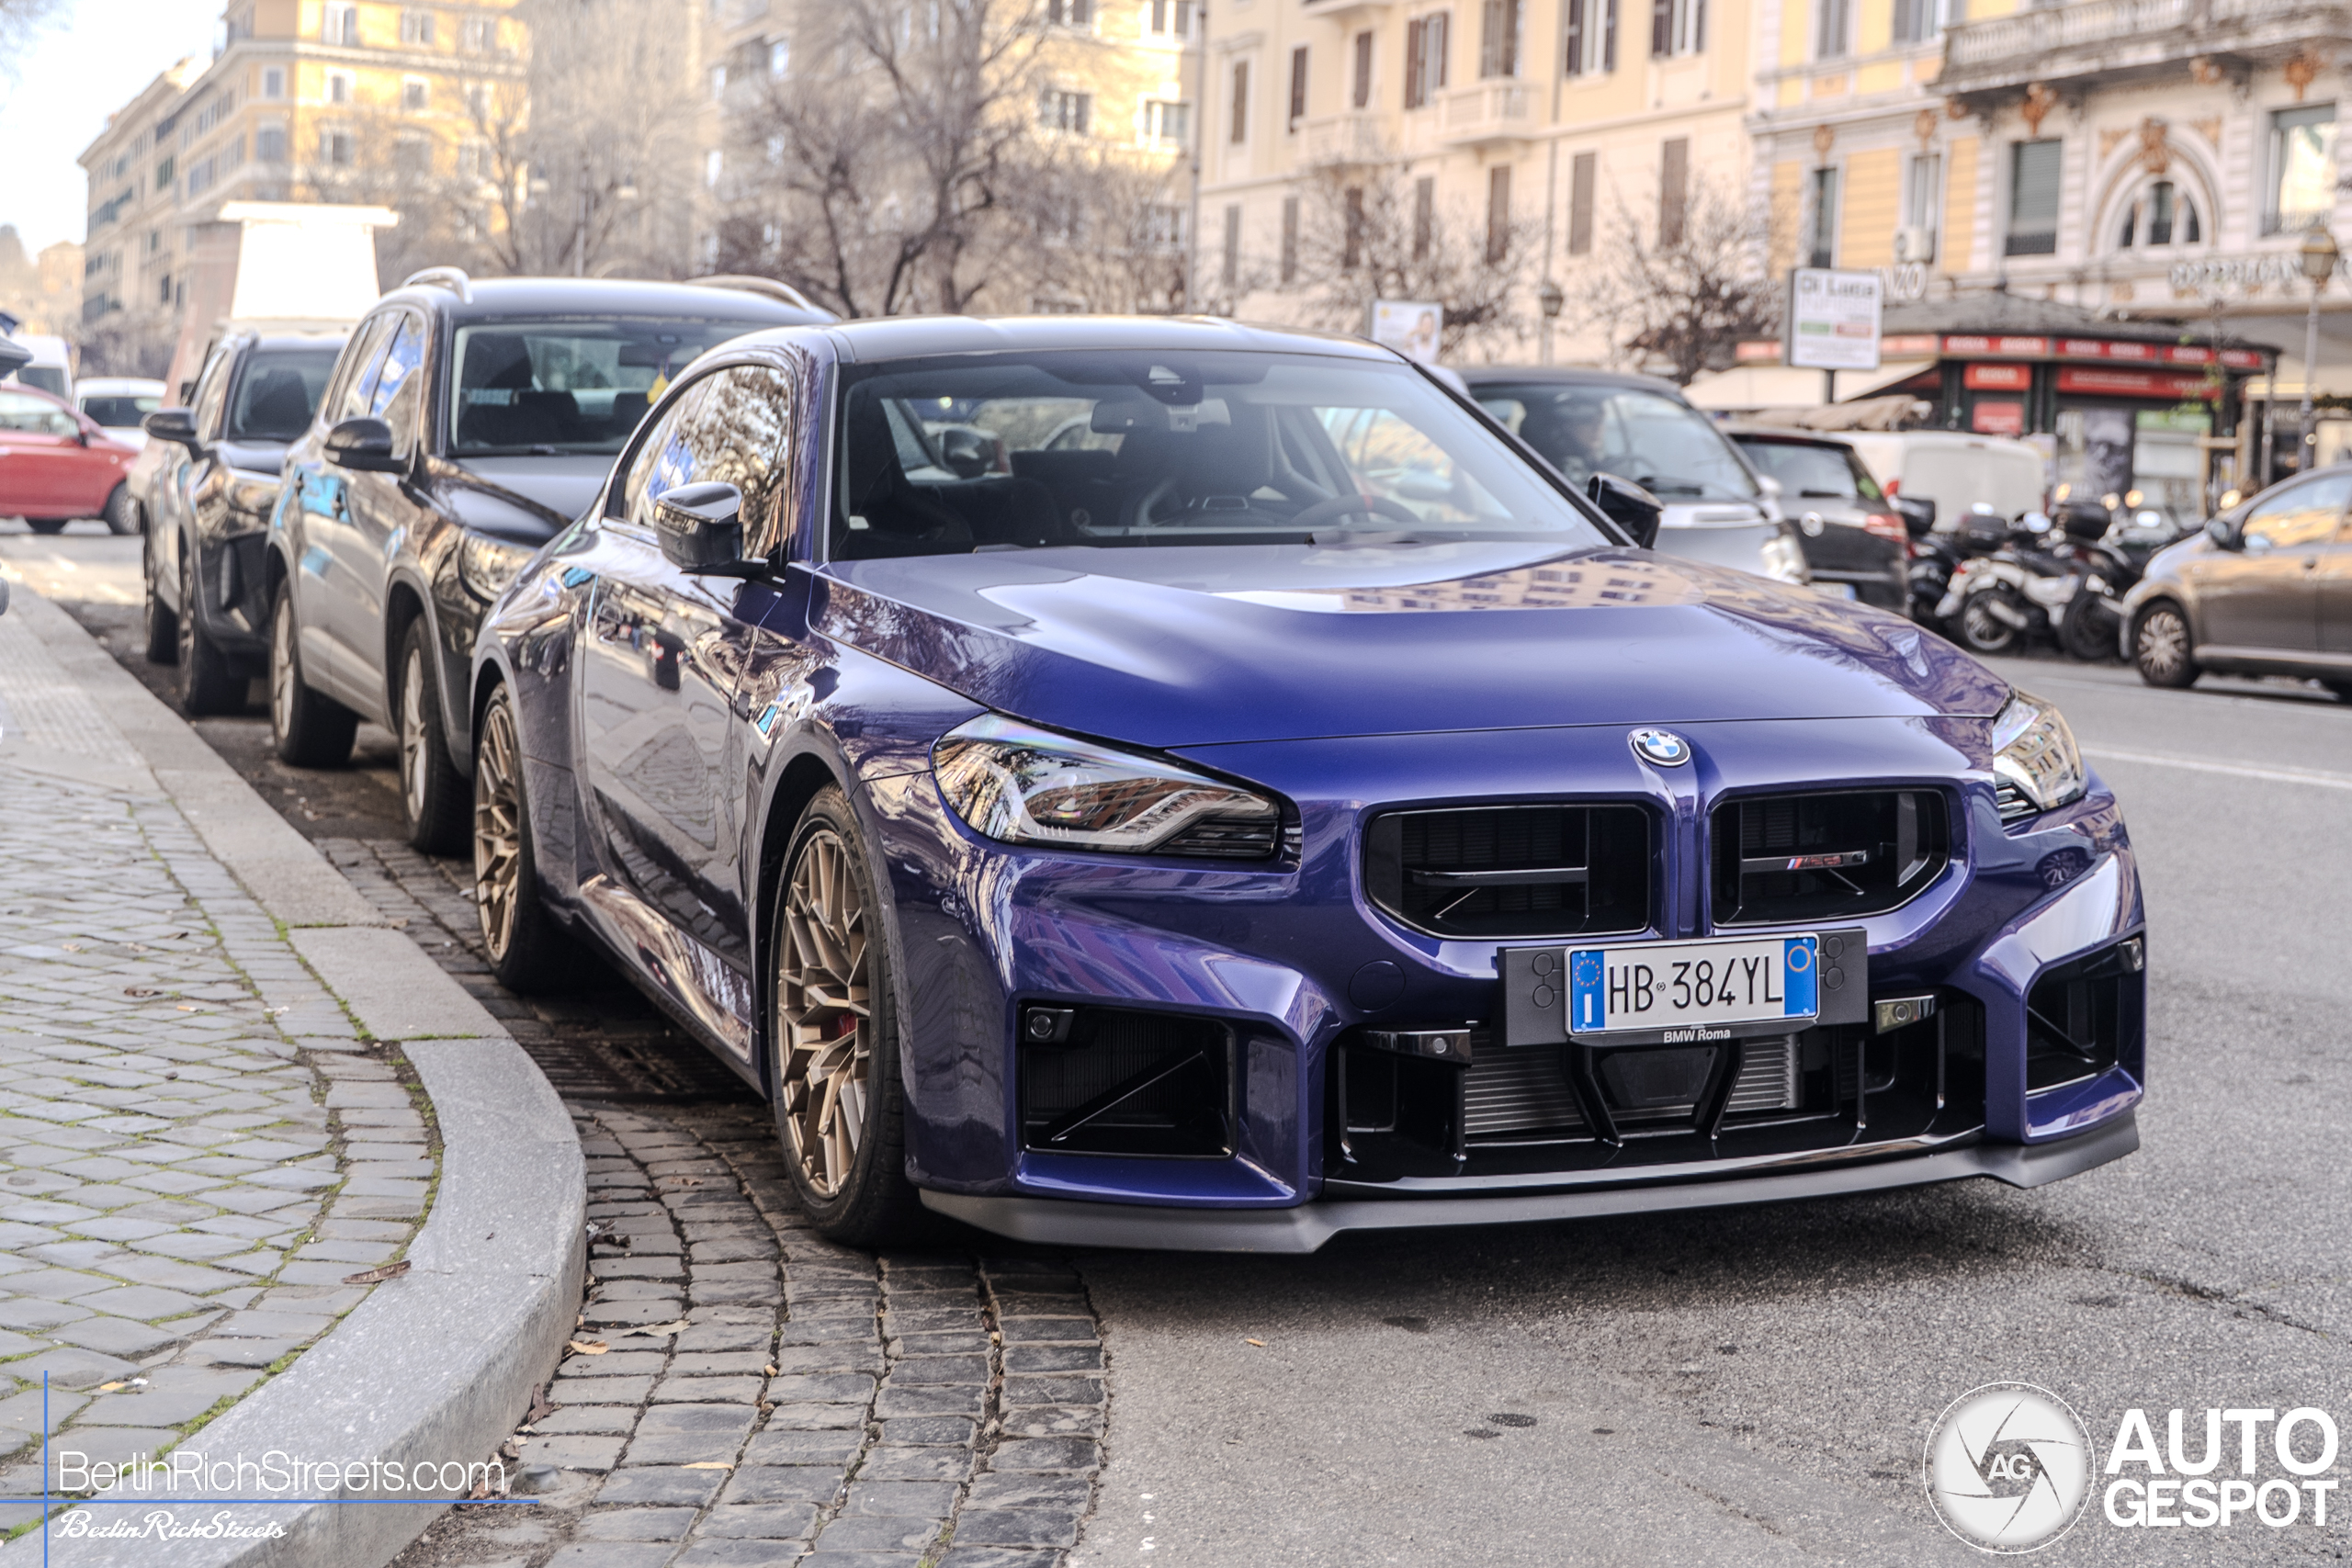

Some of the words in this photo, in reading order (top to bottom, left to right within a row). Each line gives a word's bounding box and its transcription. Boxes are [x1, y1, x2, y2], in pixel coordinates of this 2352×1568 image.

[1636, 730, 1679, 744] BMW
[1609, 964, 1655, 1014] HB
[1671, 954, 1783, 1010] 384YL
[1663, 1029, 1696, 1043] BMW
[1697, 1028, 1732, 1042] Roma
